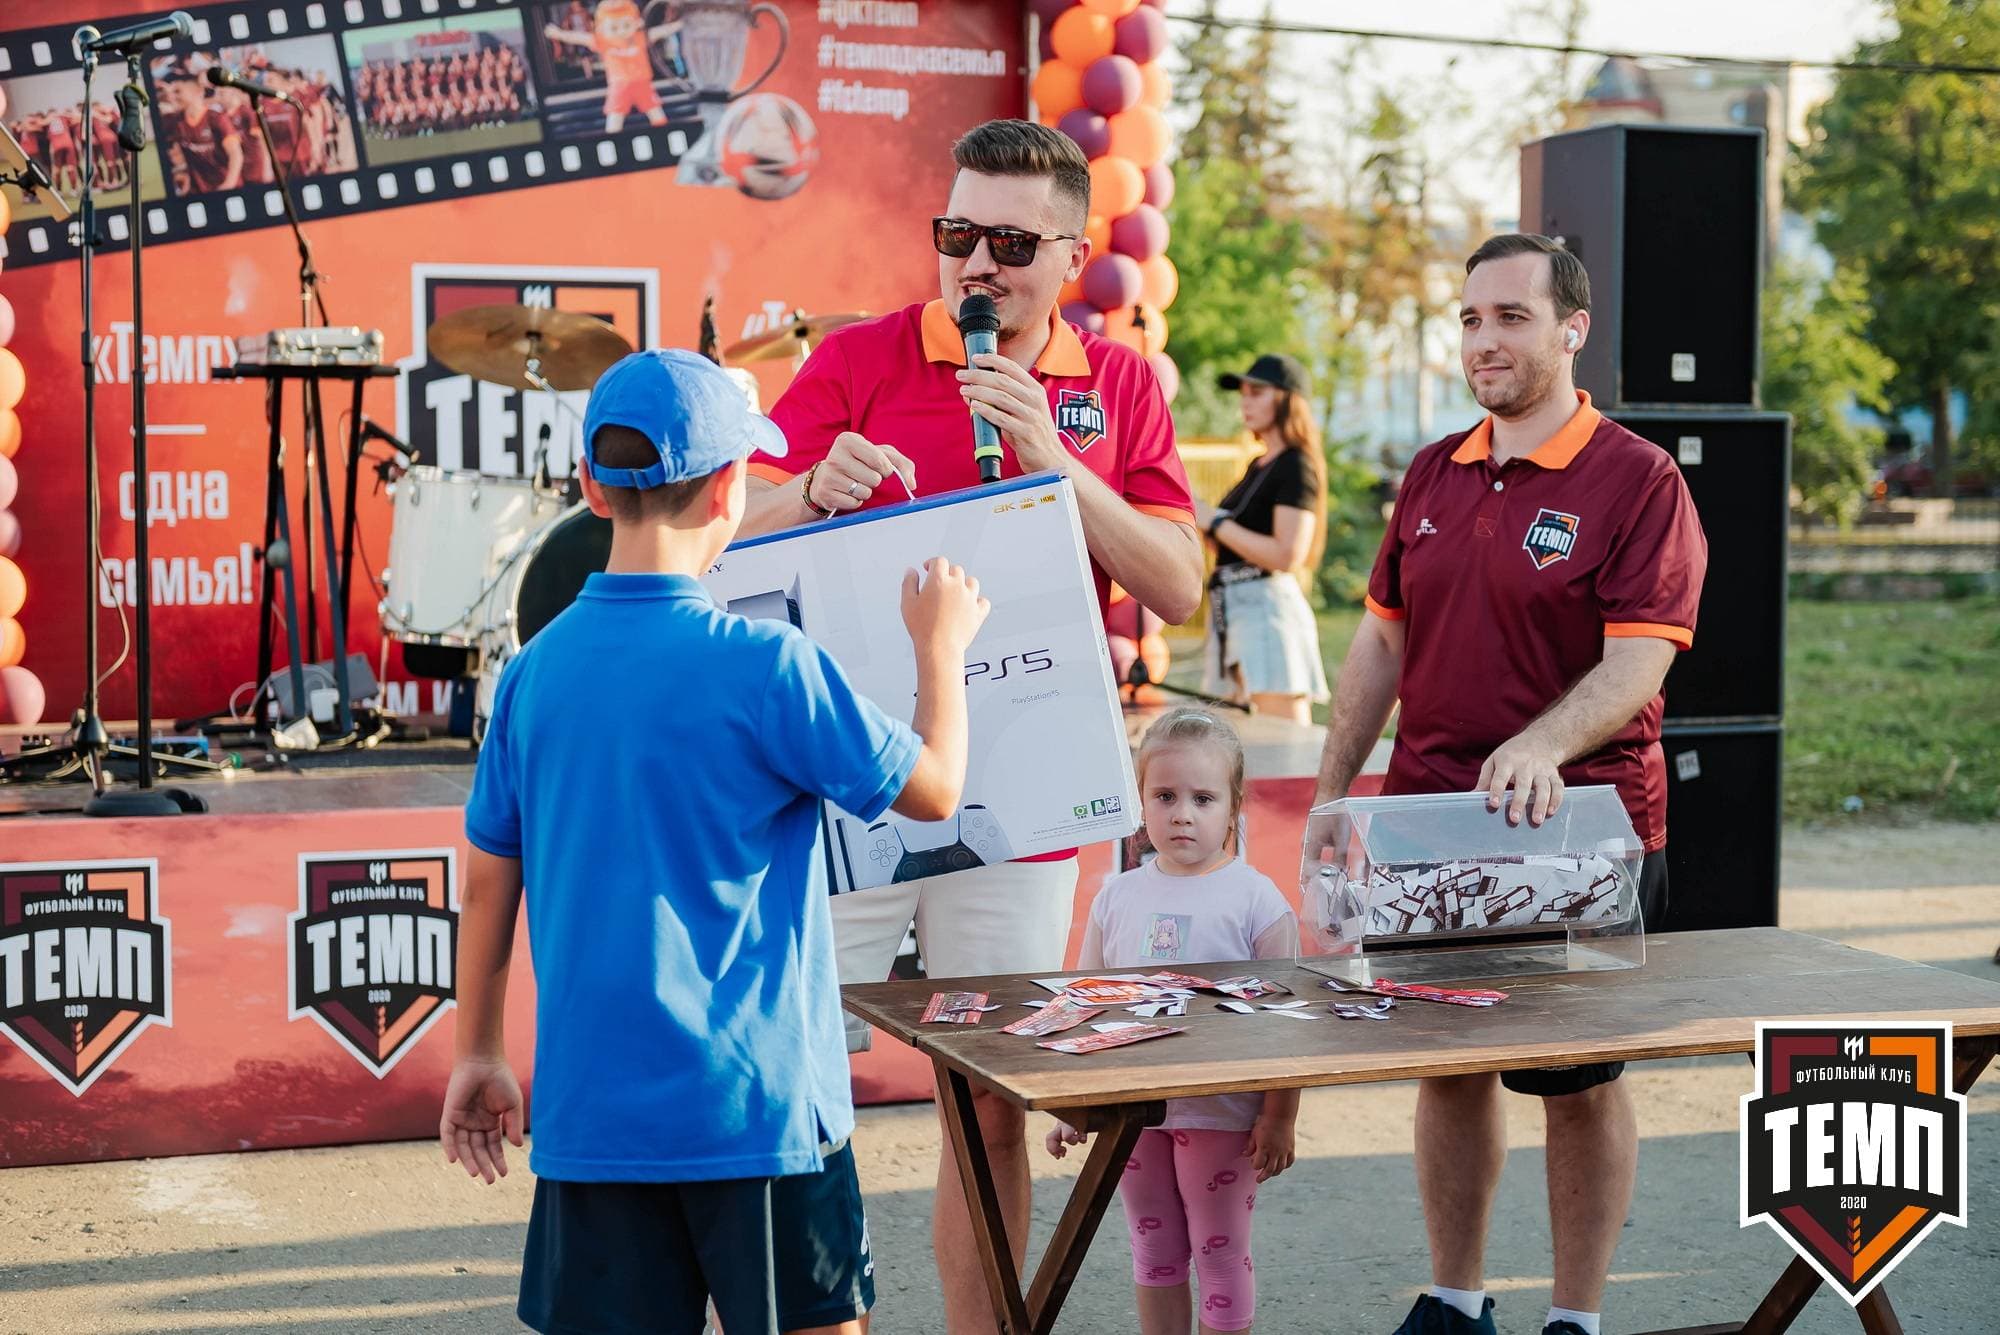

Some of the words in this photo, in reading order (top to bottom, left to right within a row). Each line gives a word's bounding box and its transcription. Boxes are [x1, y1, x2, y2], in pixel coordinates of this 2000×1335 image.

[1062, 406, 1102, 431] ТЕМП
[1530, 526, 1572, 553] ТЕМП
[965, 649, 1053, 686] PS5
[25, 896, 94, 916] ФУТБОЛЬНЫЙ
[97, 898, 124, 913] КЛУБ
[331, 884, 396, 905] ФУТБОЛЬНЫЙ
[399, 886, 425, 901] КЛУБ
[306, 913, 452, 995] ТЕМП
[0, 926, 153, 1009] ТЕМП
[367, 989, 392, 1003] 2020
[64, 1004, 88, 1018] 2020
